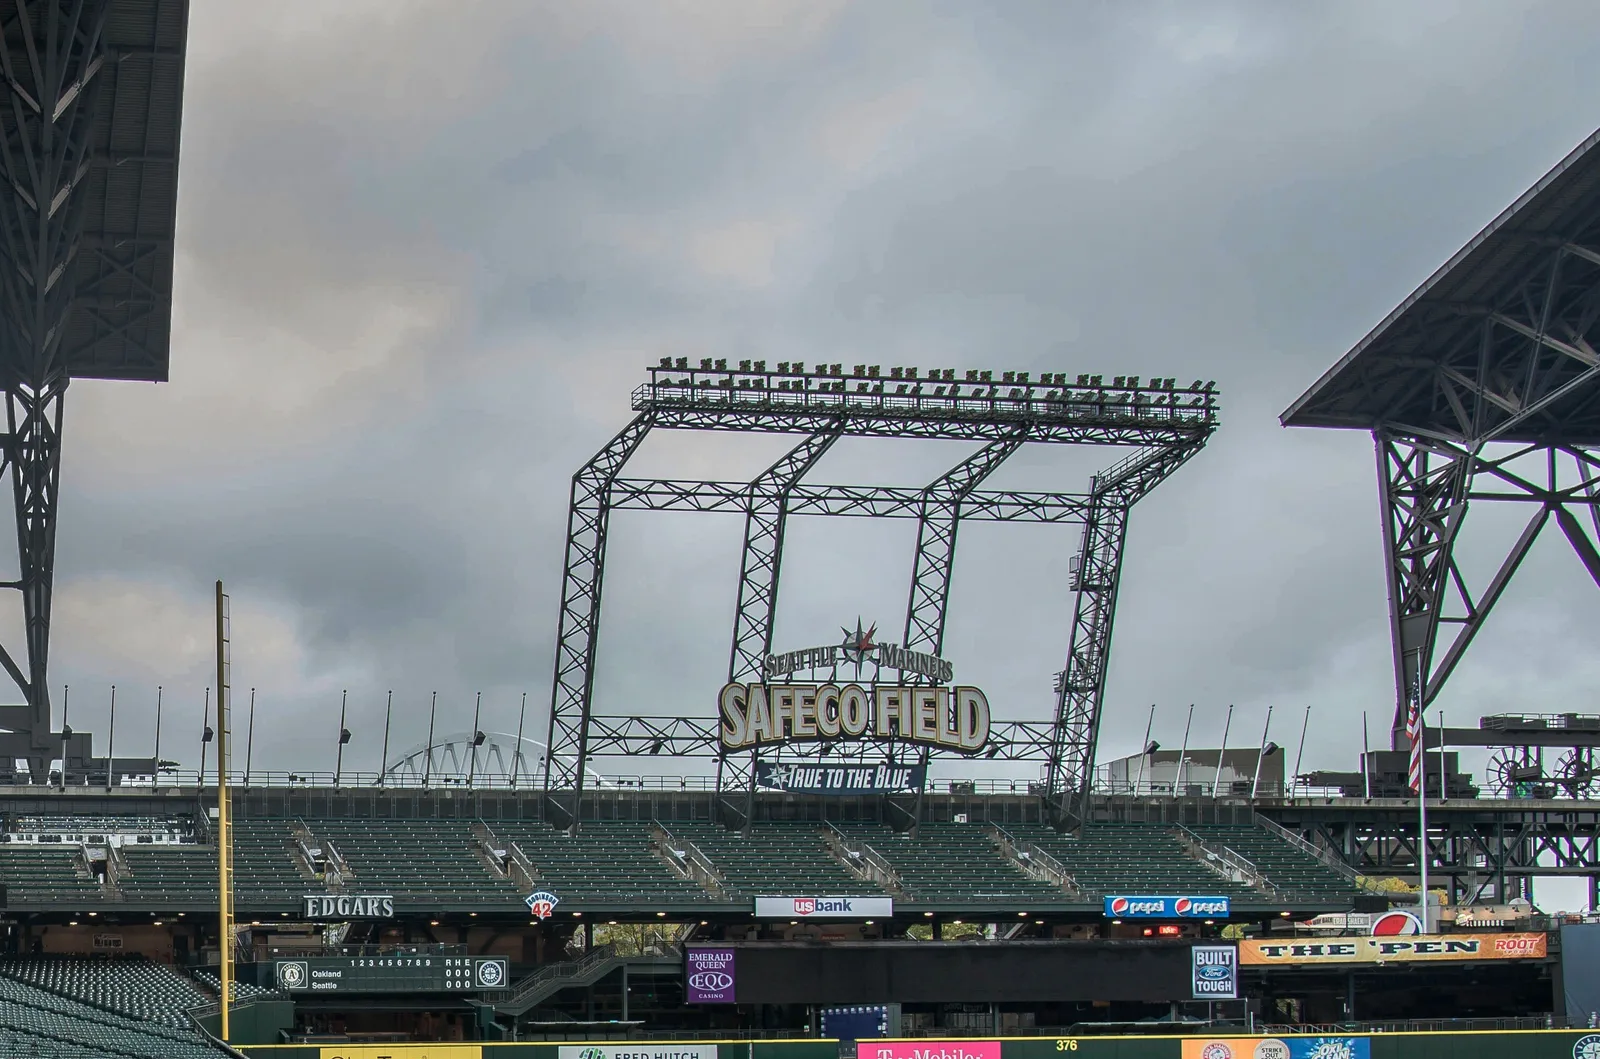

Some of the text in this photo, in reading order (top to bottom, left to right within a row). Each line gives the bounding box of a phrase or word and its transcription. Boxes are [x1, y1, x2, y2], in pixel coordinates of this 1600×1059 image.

[764, 642, 954, 683] SEATTLE MARINERS
[719, 682, 991, 754] SAFECO FIELD
[786, 764, 912, 789] TRUE TO THE BLUE
[532, 903, 552, 917] 42
[1130, 900, 1164, 914] pepsi
[1193, 900, 1227, 914] pepsi
[1259, 944, 1355, 957] THE
[1495, 939, 1539, 950] ROOT
[446, 959, 451, 967] R
[455, 959, 461, 967] H
[465, 959, 470, 967] E
[689, 953, 733, 962] EMERALD
[1196, 951, 1232, 966] BUILT
[696, 961, 726, 970] QUEEN
[312, 969, 470, 978] Oakland 0 0 0
[1204, 968, 1223, 977] Ford
[312, 981, 470, 990] Seattle 0 0 0
[695, 974, 729, 991] EQC
[1196, 980, 1232, 992] TOUGH
[1056, 1040, 1077, 1051] 376
[1320, 1043, 1340, 1056] OXI
